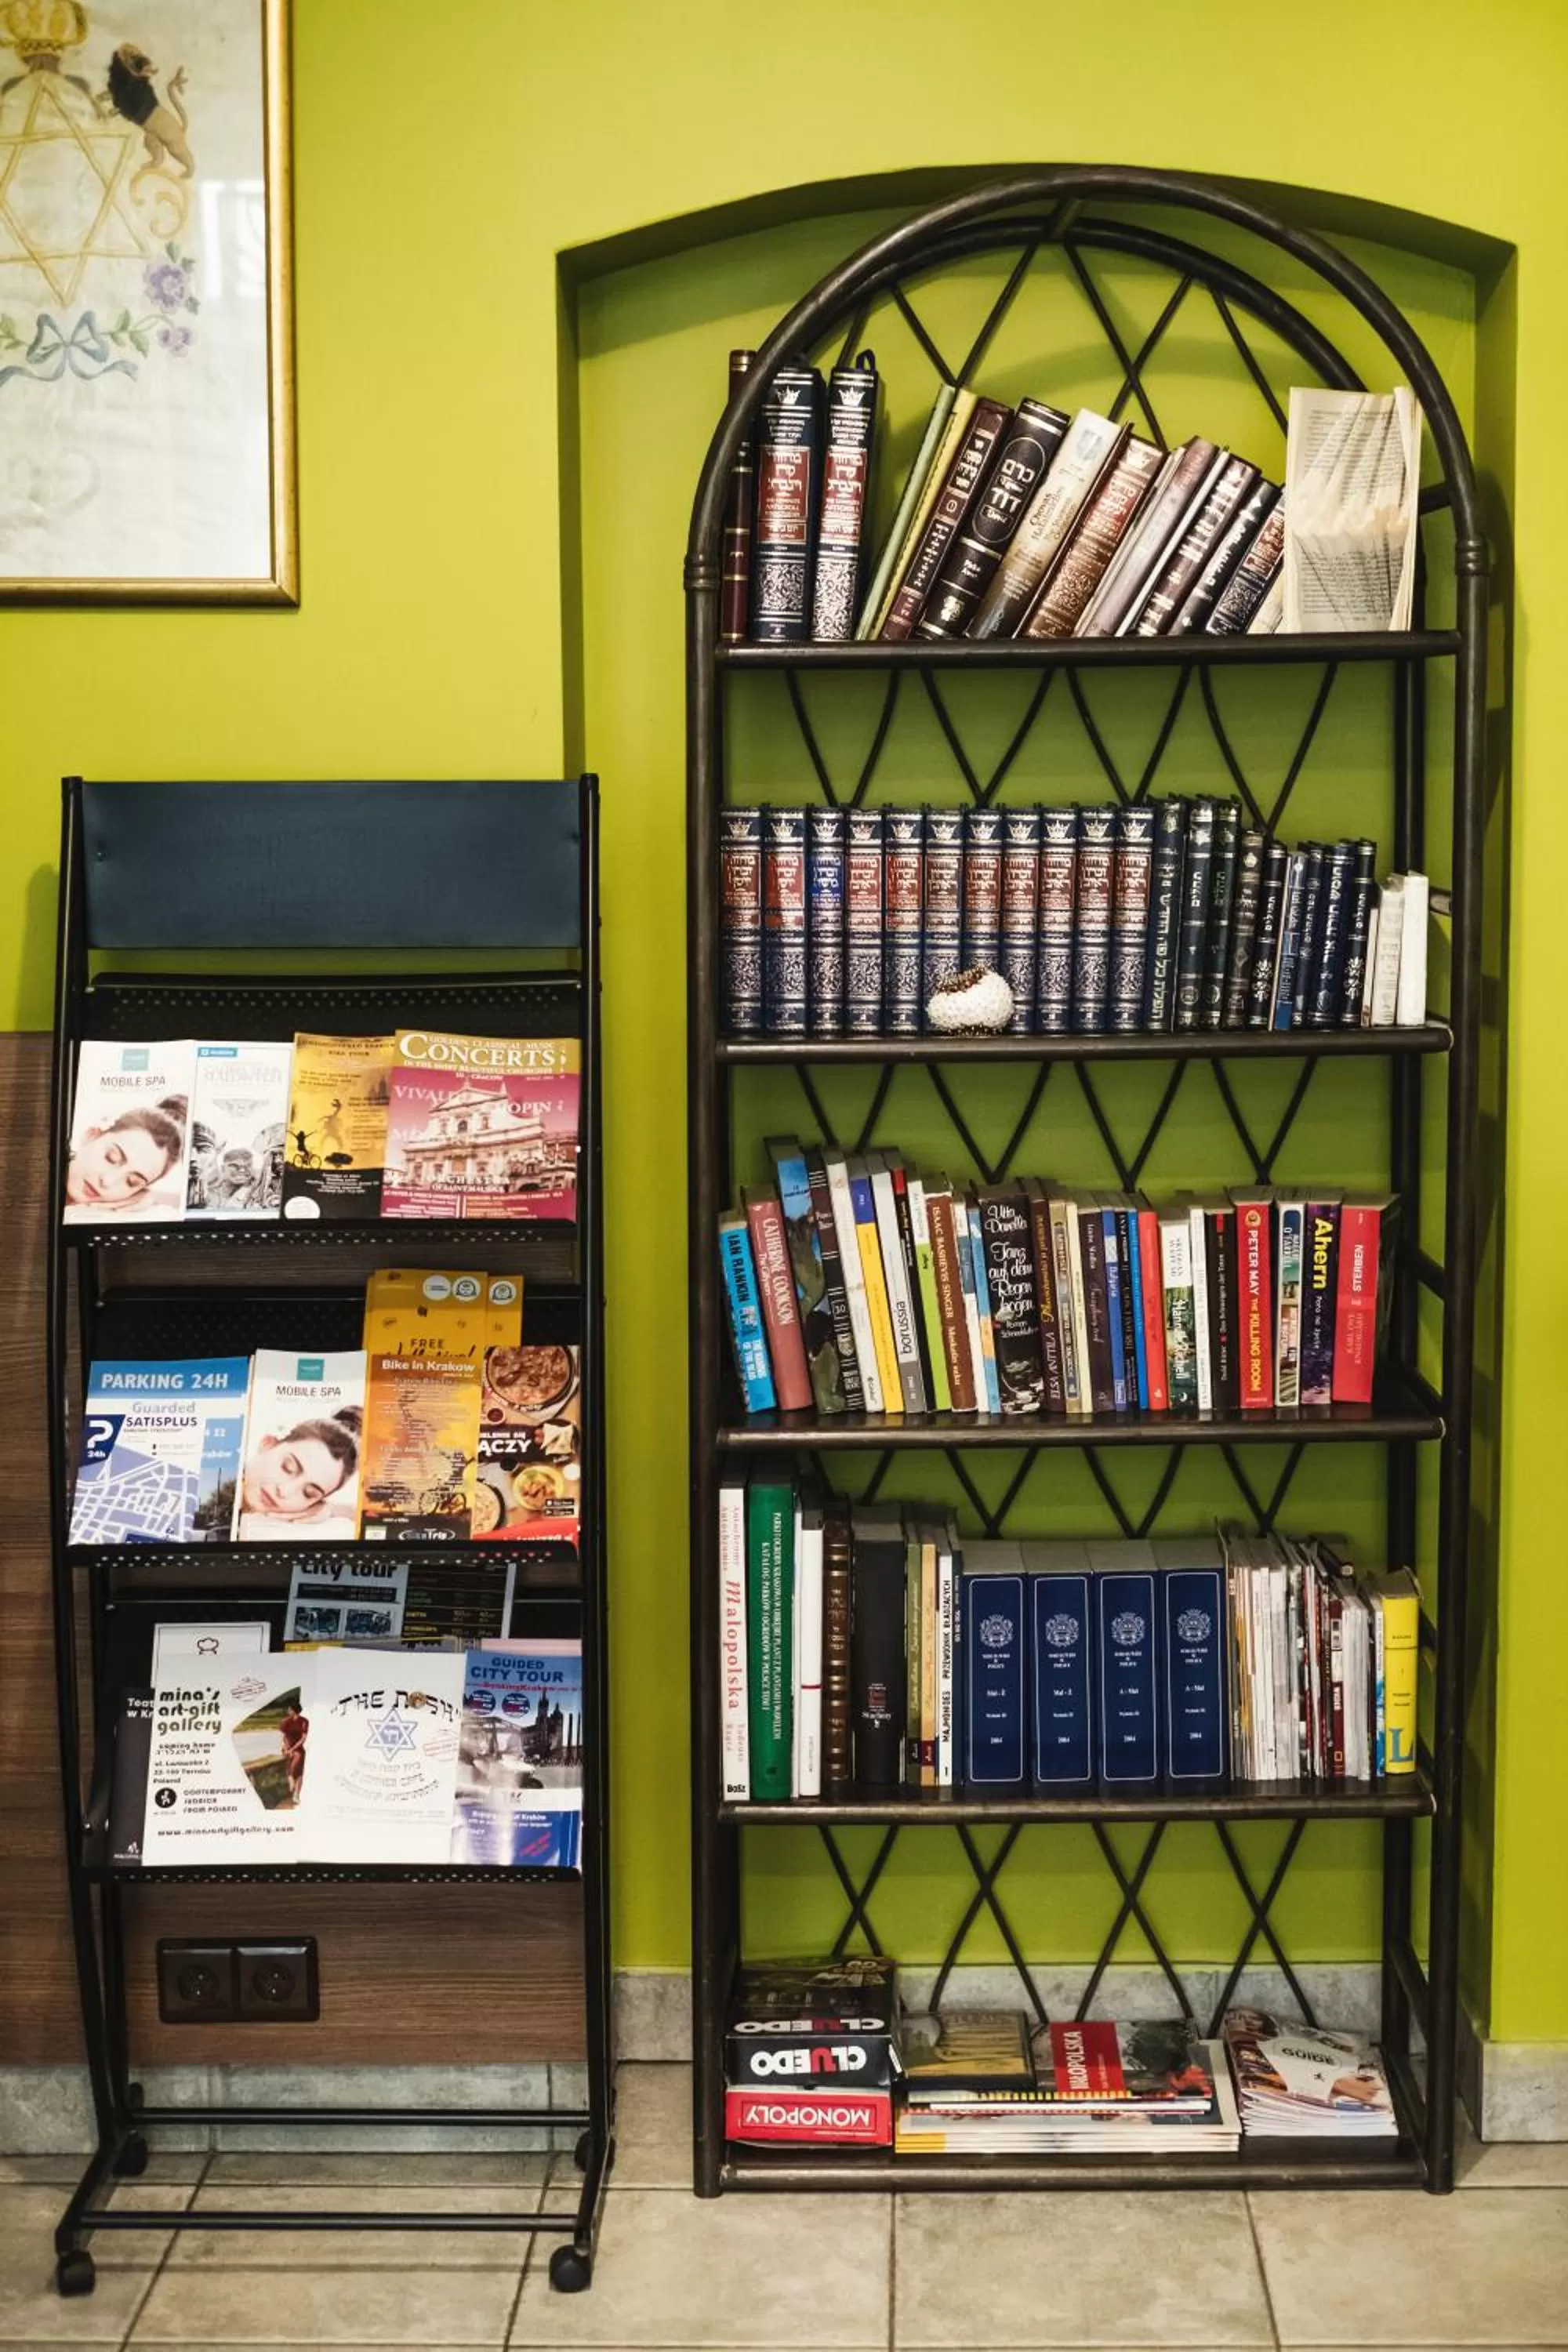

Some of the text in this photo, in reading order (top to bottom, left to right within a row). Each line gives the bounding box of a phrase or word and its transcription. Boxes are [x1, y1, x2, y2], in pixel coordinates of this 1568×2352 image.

[1157, 937, 1169, 956] פה
[1155, 960, 1171, 978] כל
[1151, 980, 1167, 1018] תפלת
[400, 1034, 555, 1066] CONCERTS
[100, 1076, 165, 1086] MOBILE SPA
[932, 1207, 943, 1236] ISAAC
[1248, 1230, 1258, 1267] PETER
[1312, 1218, 1333, 1289] Ahern
[727, 1235, 750, 1302] IAN RANKIN
[935, 1238, 949, 1282] BASHEVIS
[1352, 1244, 1363, 1292] STERBEN
[763, 1218, 794, 1325] CATHERINE COOKSON
[1249, 1270, 1258, 1295] MAY
[942, 1284, 954, 1318] SINGER
[896, 1301, 911, 1353] borussia
[1250, 1313, 1260, 1356] KILLING
[410, 1338, 445, 1349] FREE
[382, 1359, 475, 1373] Bike in Krakow
[1250, 1359, 1261, 1392] ROOM
[101, 1374, 228, 1389] PARKING 24H
[276, 1385, 341, 1397] MOBILE SPA
[1049, 1376, 1061, 1399] ELSA
[132, 1402, 195, 1414] Guarded
[126, 1417, 198, 1427] SATISPLUS
[478, 1439, 532, 1456] ĄCZY
[761, 1542, 771, 1579] KATALOG
[471, 1666, 564, 1682] CITY TOUR
[491, 1657, 545, 1669] GUIDED
[159, 1687, 220, 1701] mina's
[158, 1702, 220, 1720] art-gift
[158, 1719, 222, 1736] gallery
[734, 2017, 885, 2034] CLUEDO
[750, 2045, 867, 2077] CLUEDO
[746, 2105, 870, 2127] MONOPOLY
